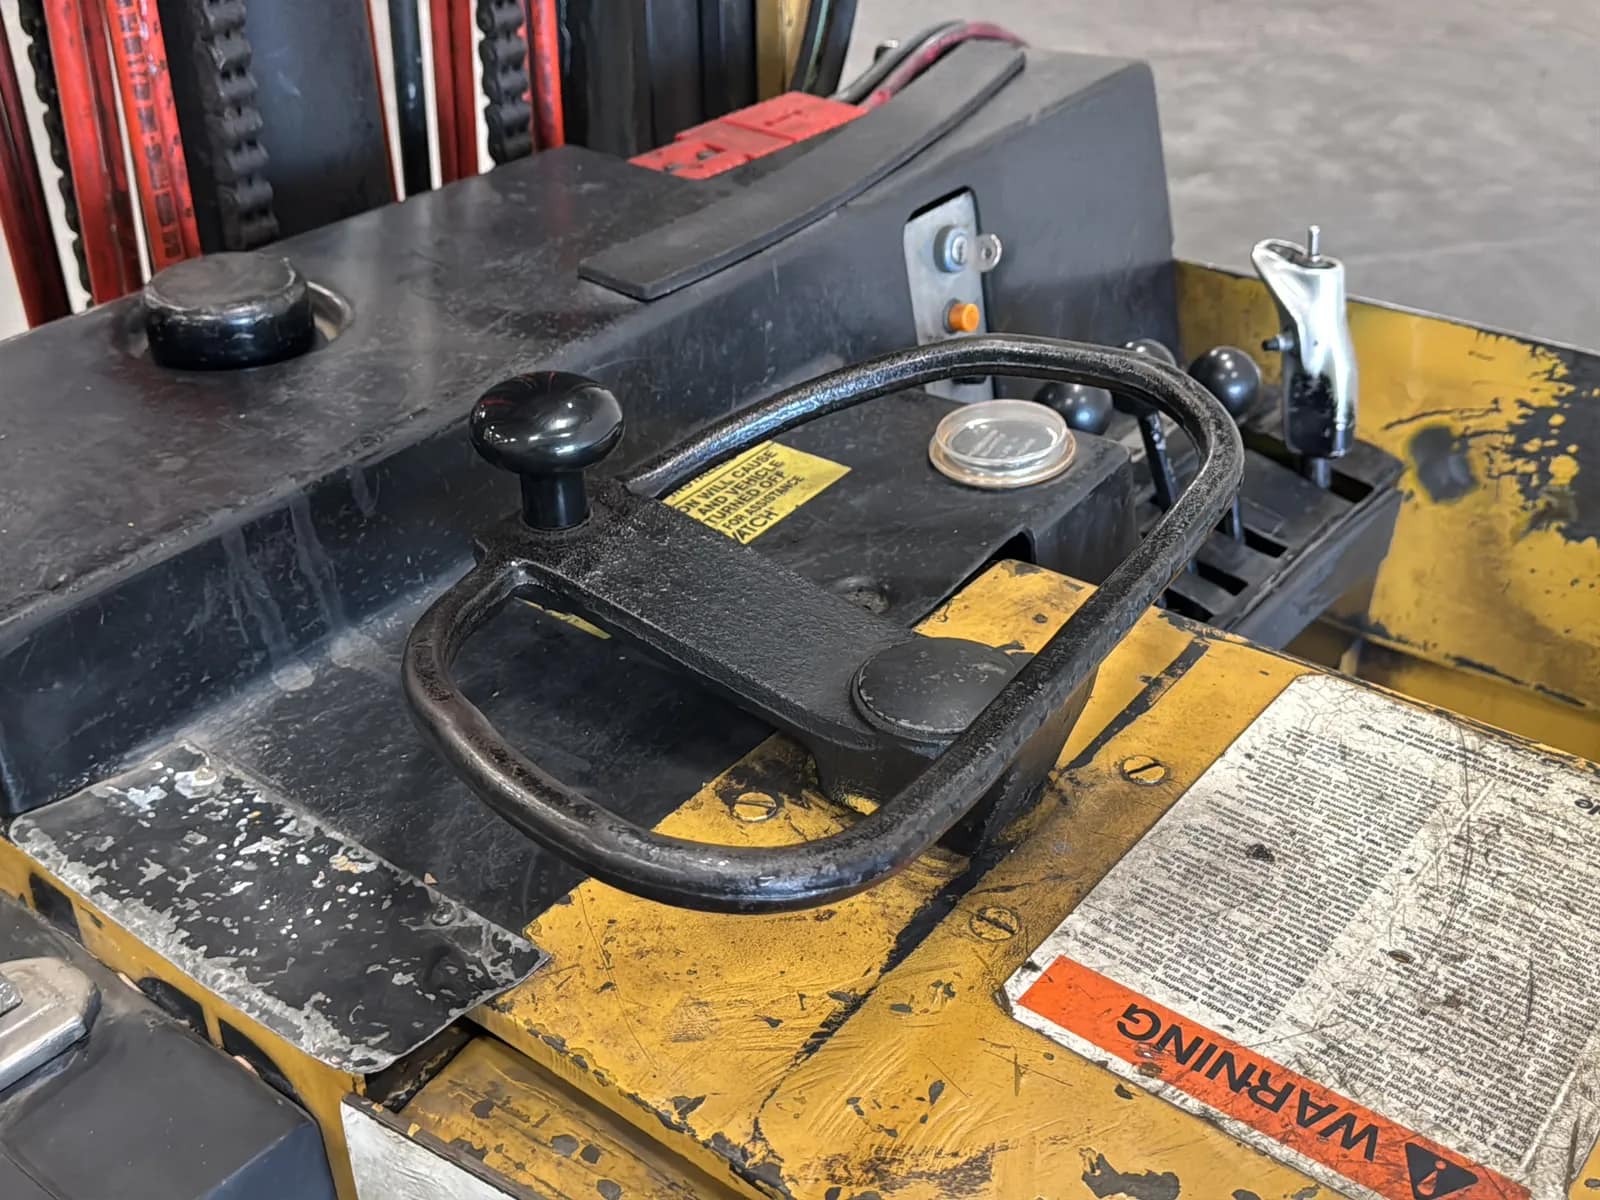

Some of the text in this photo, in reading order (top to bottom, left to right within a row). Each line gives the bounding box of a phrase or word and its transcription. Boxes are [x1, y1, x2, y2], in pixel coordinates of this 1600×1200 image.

[697, 495, 728, 516] AND
[728, 460, 785, 495] VEHICLE
[702, 479, 732, 500] WILL
[732, 450, 777, 478] CAUSE
[703, 487, 760, 525] TURNED
[761, 470, 786, 491] OFF
[722, 515, 745, 530] FOR
[745, 475, 806, 515] ASSISTANCE
[1116, 1003, 1381, 1162] WARNING
